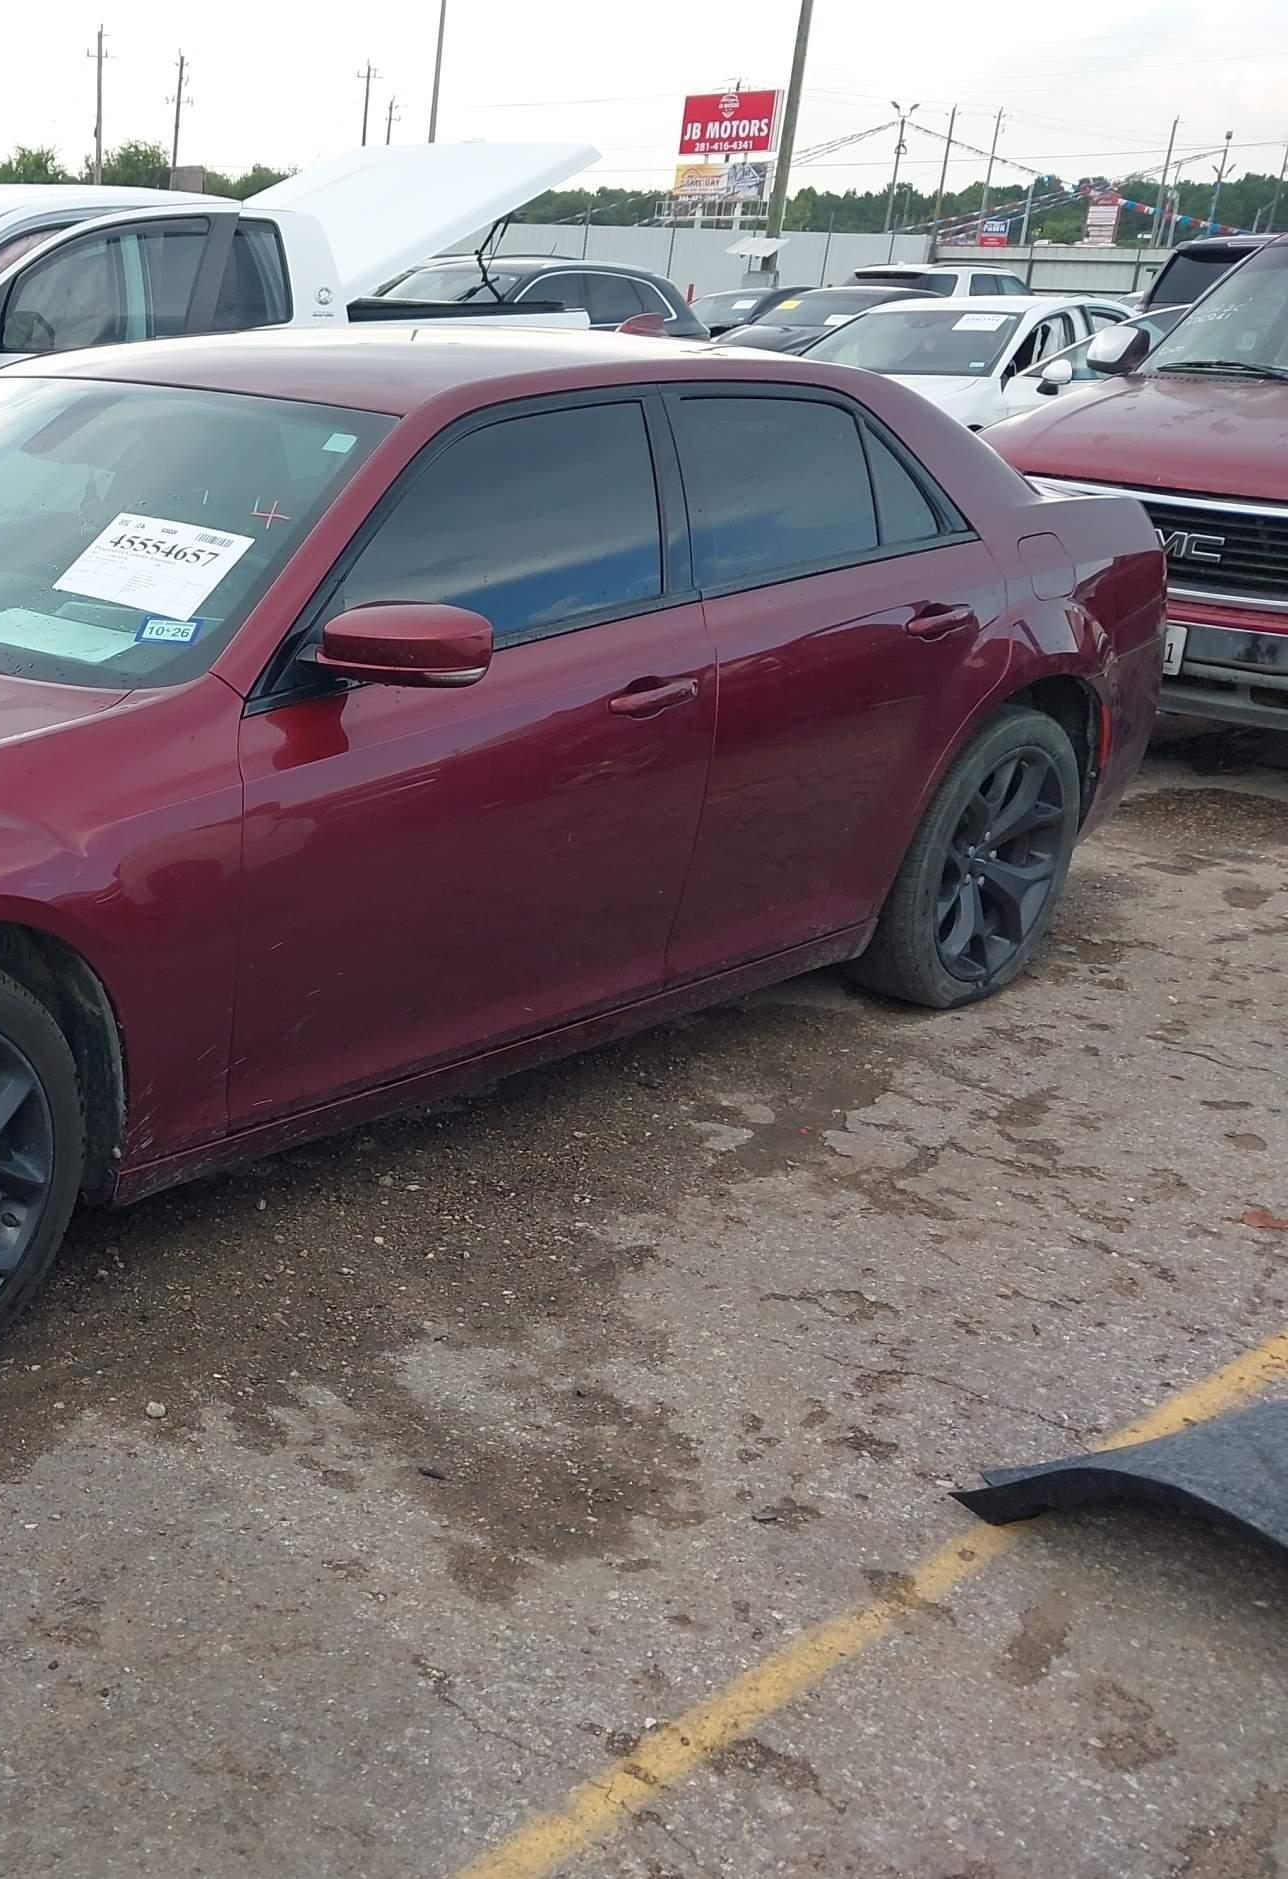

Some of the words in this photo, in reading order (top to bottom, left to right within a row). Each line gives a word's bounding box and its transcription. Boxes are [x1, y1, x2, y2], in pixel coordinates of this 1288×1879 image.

[684, 123, 701, 140] JB
[706, 118, 769, 139] MOTORS
[694, 141, 753, 152] 281-416-4341
[109, 534, 220, 567] 45554657
[1154, 528, 1225, 562] MC
